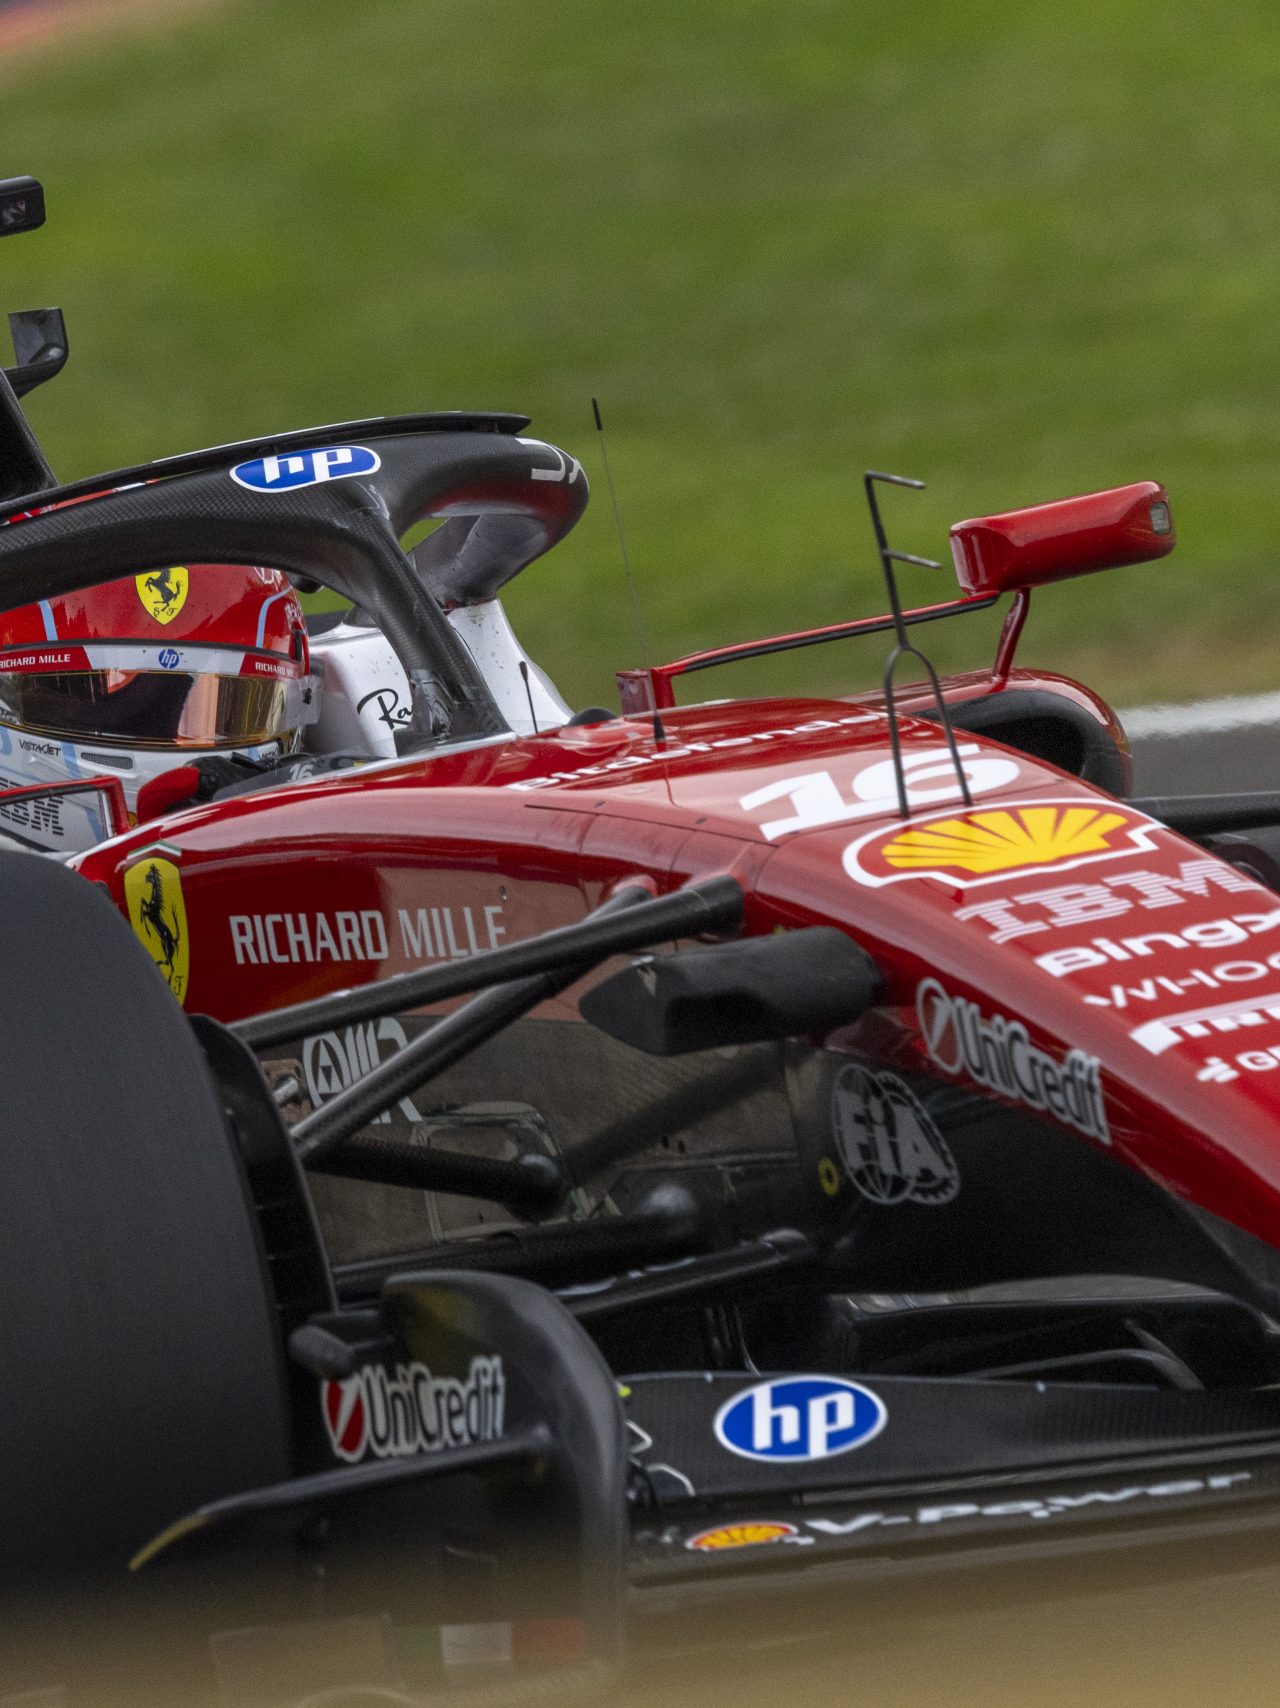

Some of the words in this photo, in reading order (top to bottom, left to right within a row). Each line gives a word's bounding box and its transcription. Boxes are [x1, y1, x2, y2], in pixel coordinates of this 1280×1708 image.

[261, 448, 354, 485] hp
[38, 653, 71, 665] MILLE
[255, 661, 286, 676] RICHARD
[288, 763, 314, 783] 16
[739, 743, 1020, 841] 16
[952, 859, 1270, 944] IBM
[229, 910, 388, 965] RICHARD
[398, 906, 507, 959] MILLE
[953, 996, 1113, 1145] UniCredit
[362, 1354, 505, 1457] UniCredit
[754, 1384, 855, 1458] hp
